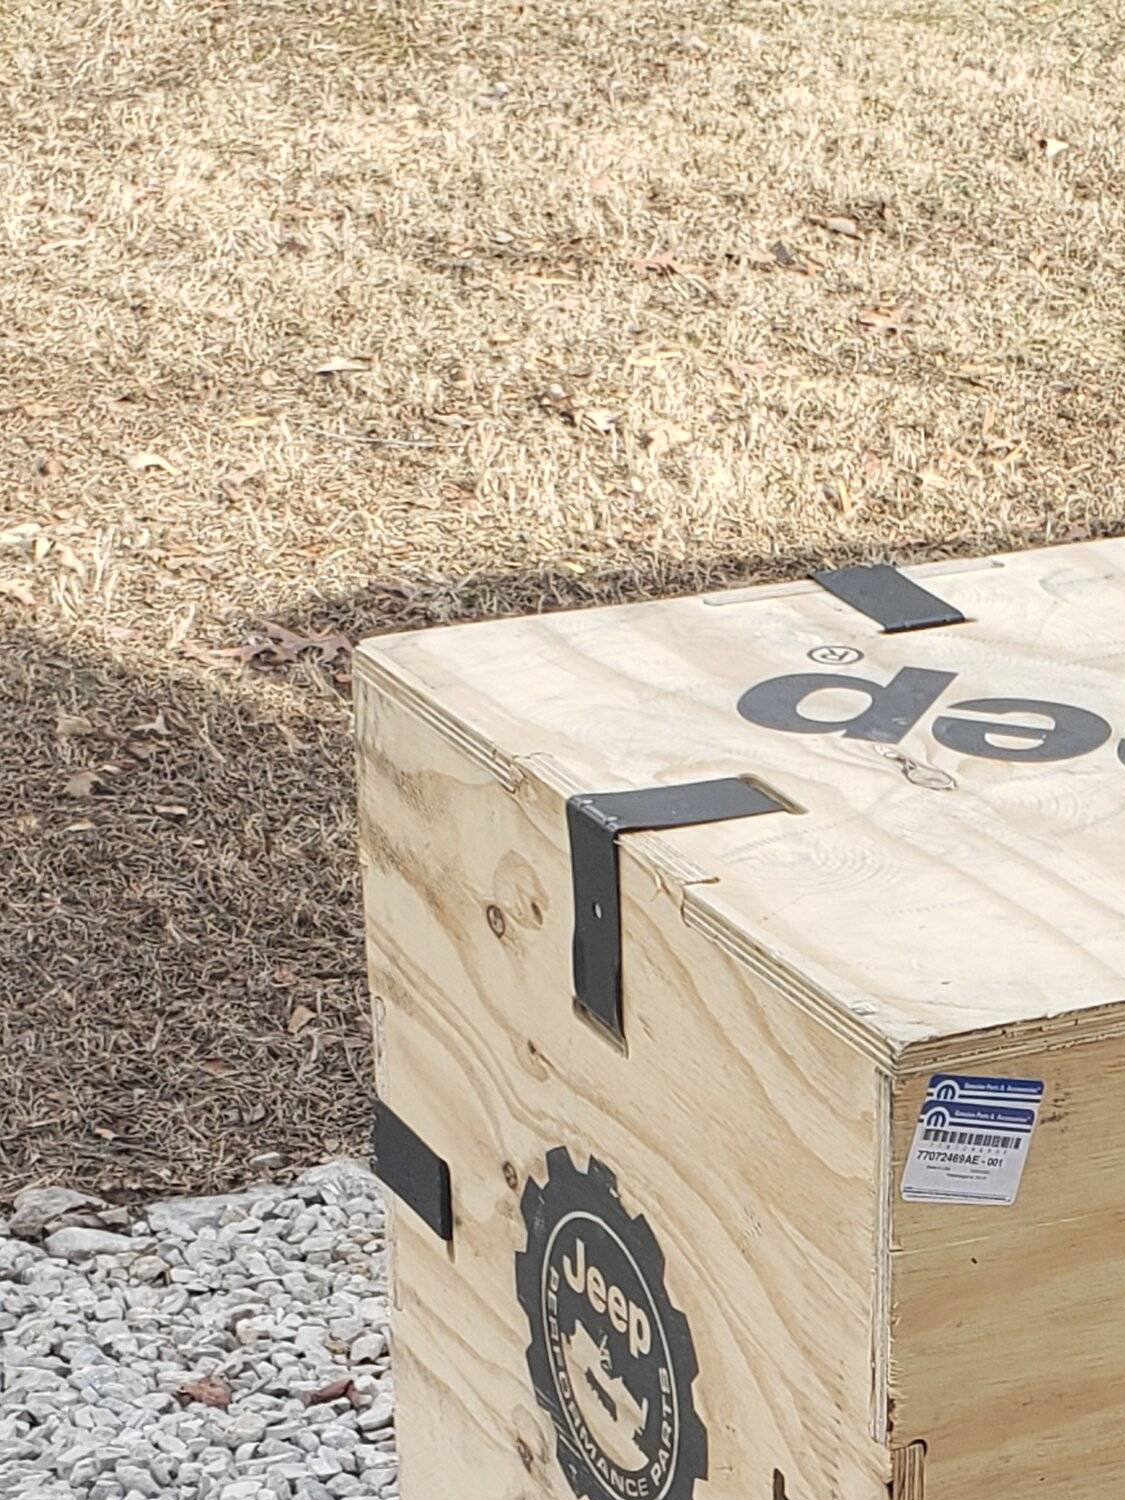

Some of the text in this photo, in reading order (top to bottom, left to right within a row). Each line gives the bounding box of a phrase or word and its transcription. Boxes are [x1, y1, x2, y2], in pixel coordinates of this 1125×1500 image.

[548, 1266, 677, 1497] PERFORMANCE PARTS
[564, 1238, 652, 1359] Jeep
